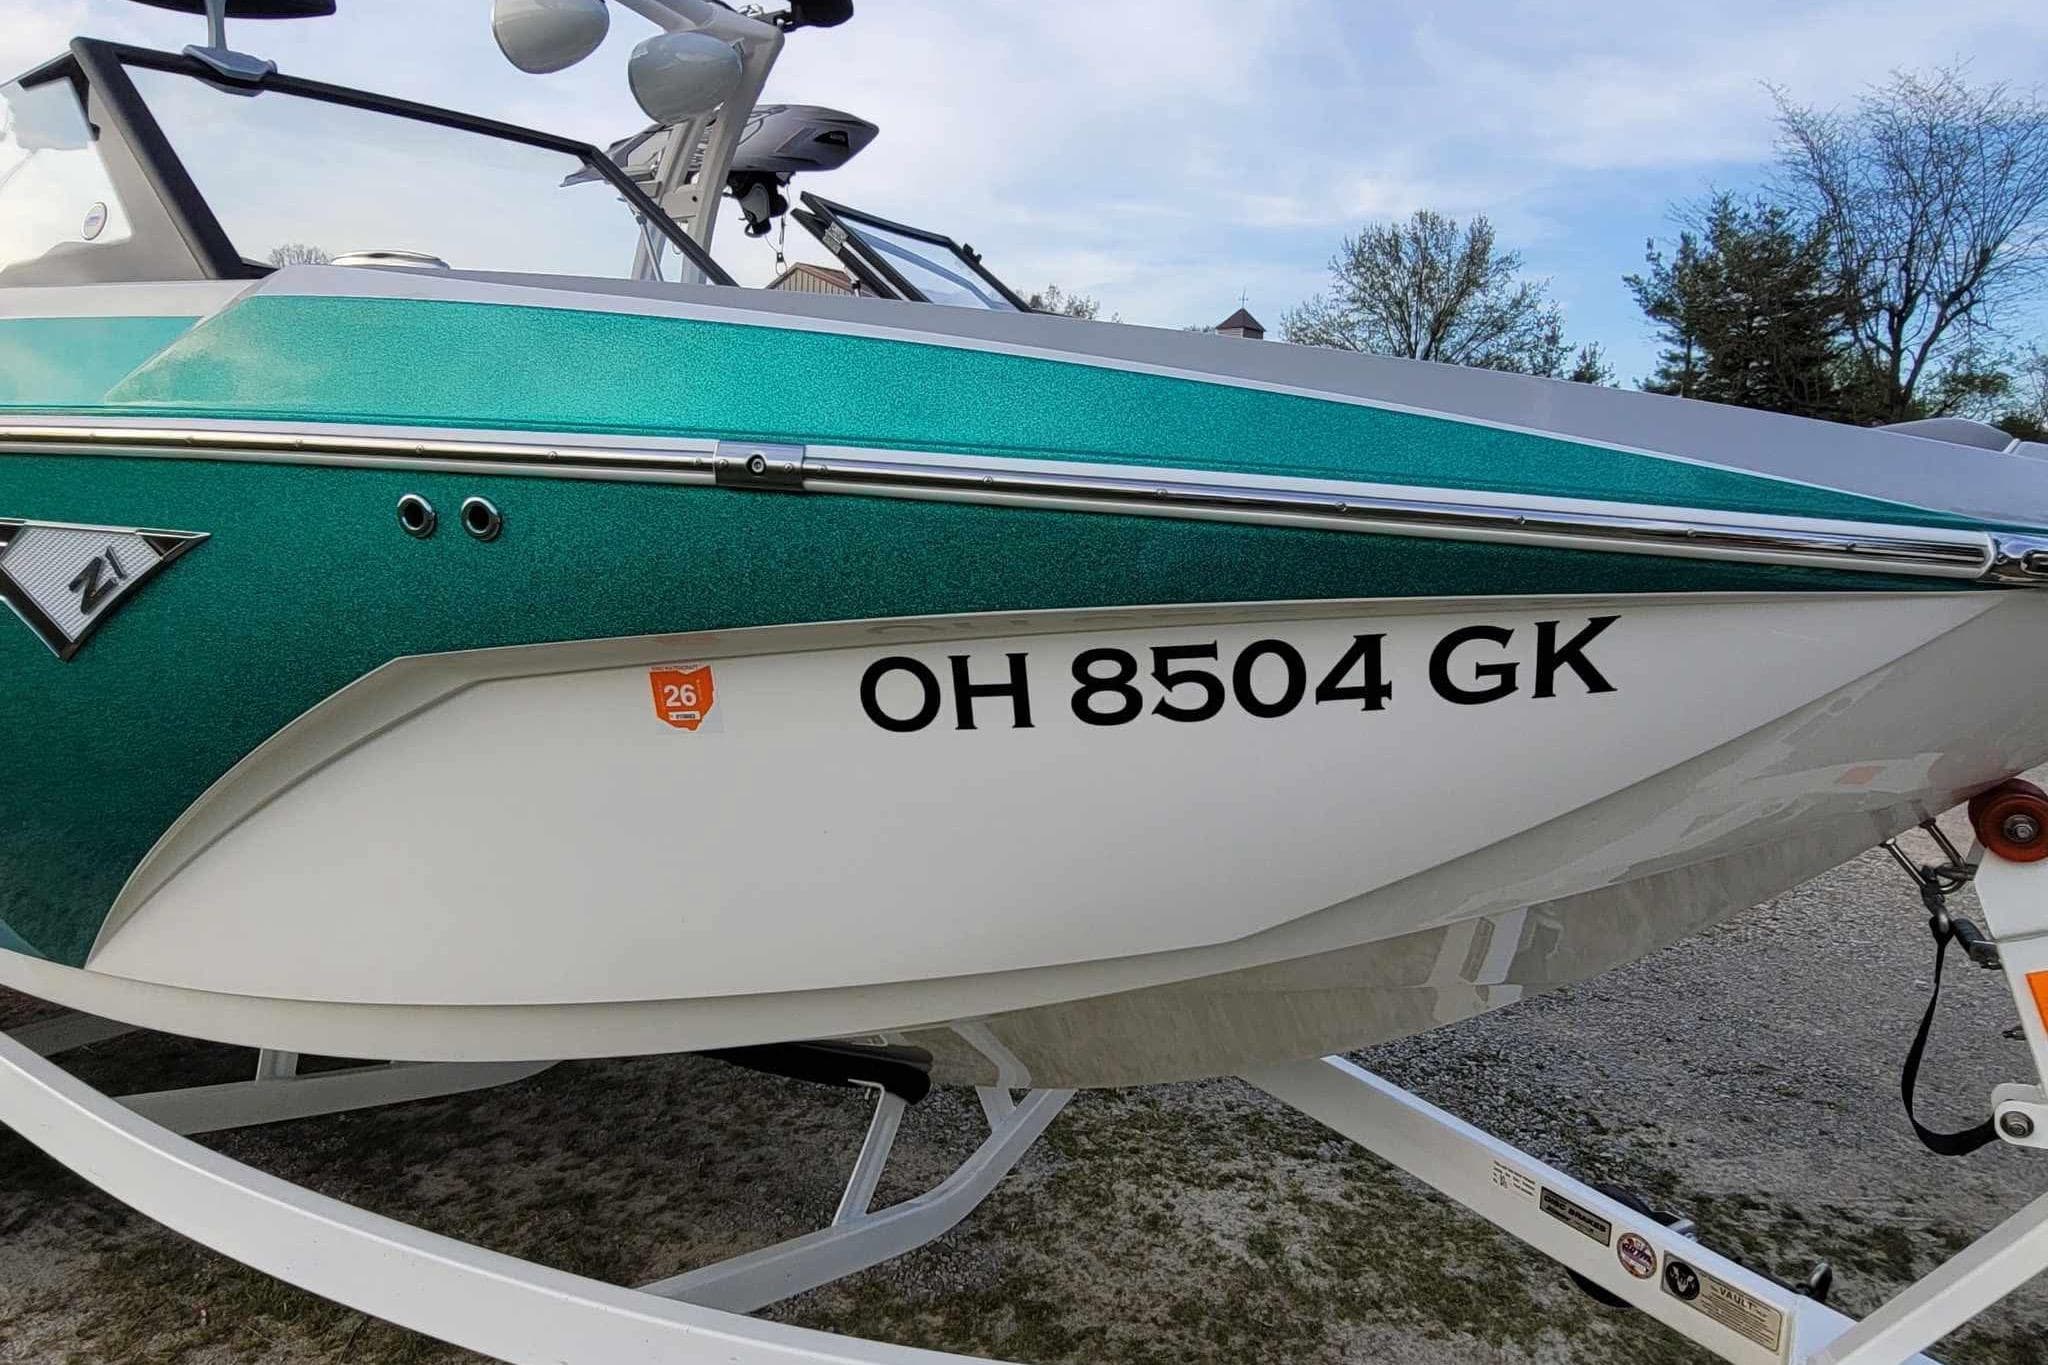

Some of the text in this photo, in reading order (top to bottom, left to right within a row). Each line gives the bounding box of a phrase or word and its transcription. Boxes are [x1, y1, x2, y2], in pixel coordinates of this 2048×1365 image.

[859, 615, 1623, 732] OH 8504 GK
[664, 684, 697, 707] 26
[1719, 1287, 1754, 1311] VAULT
